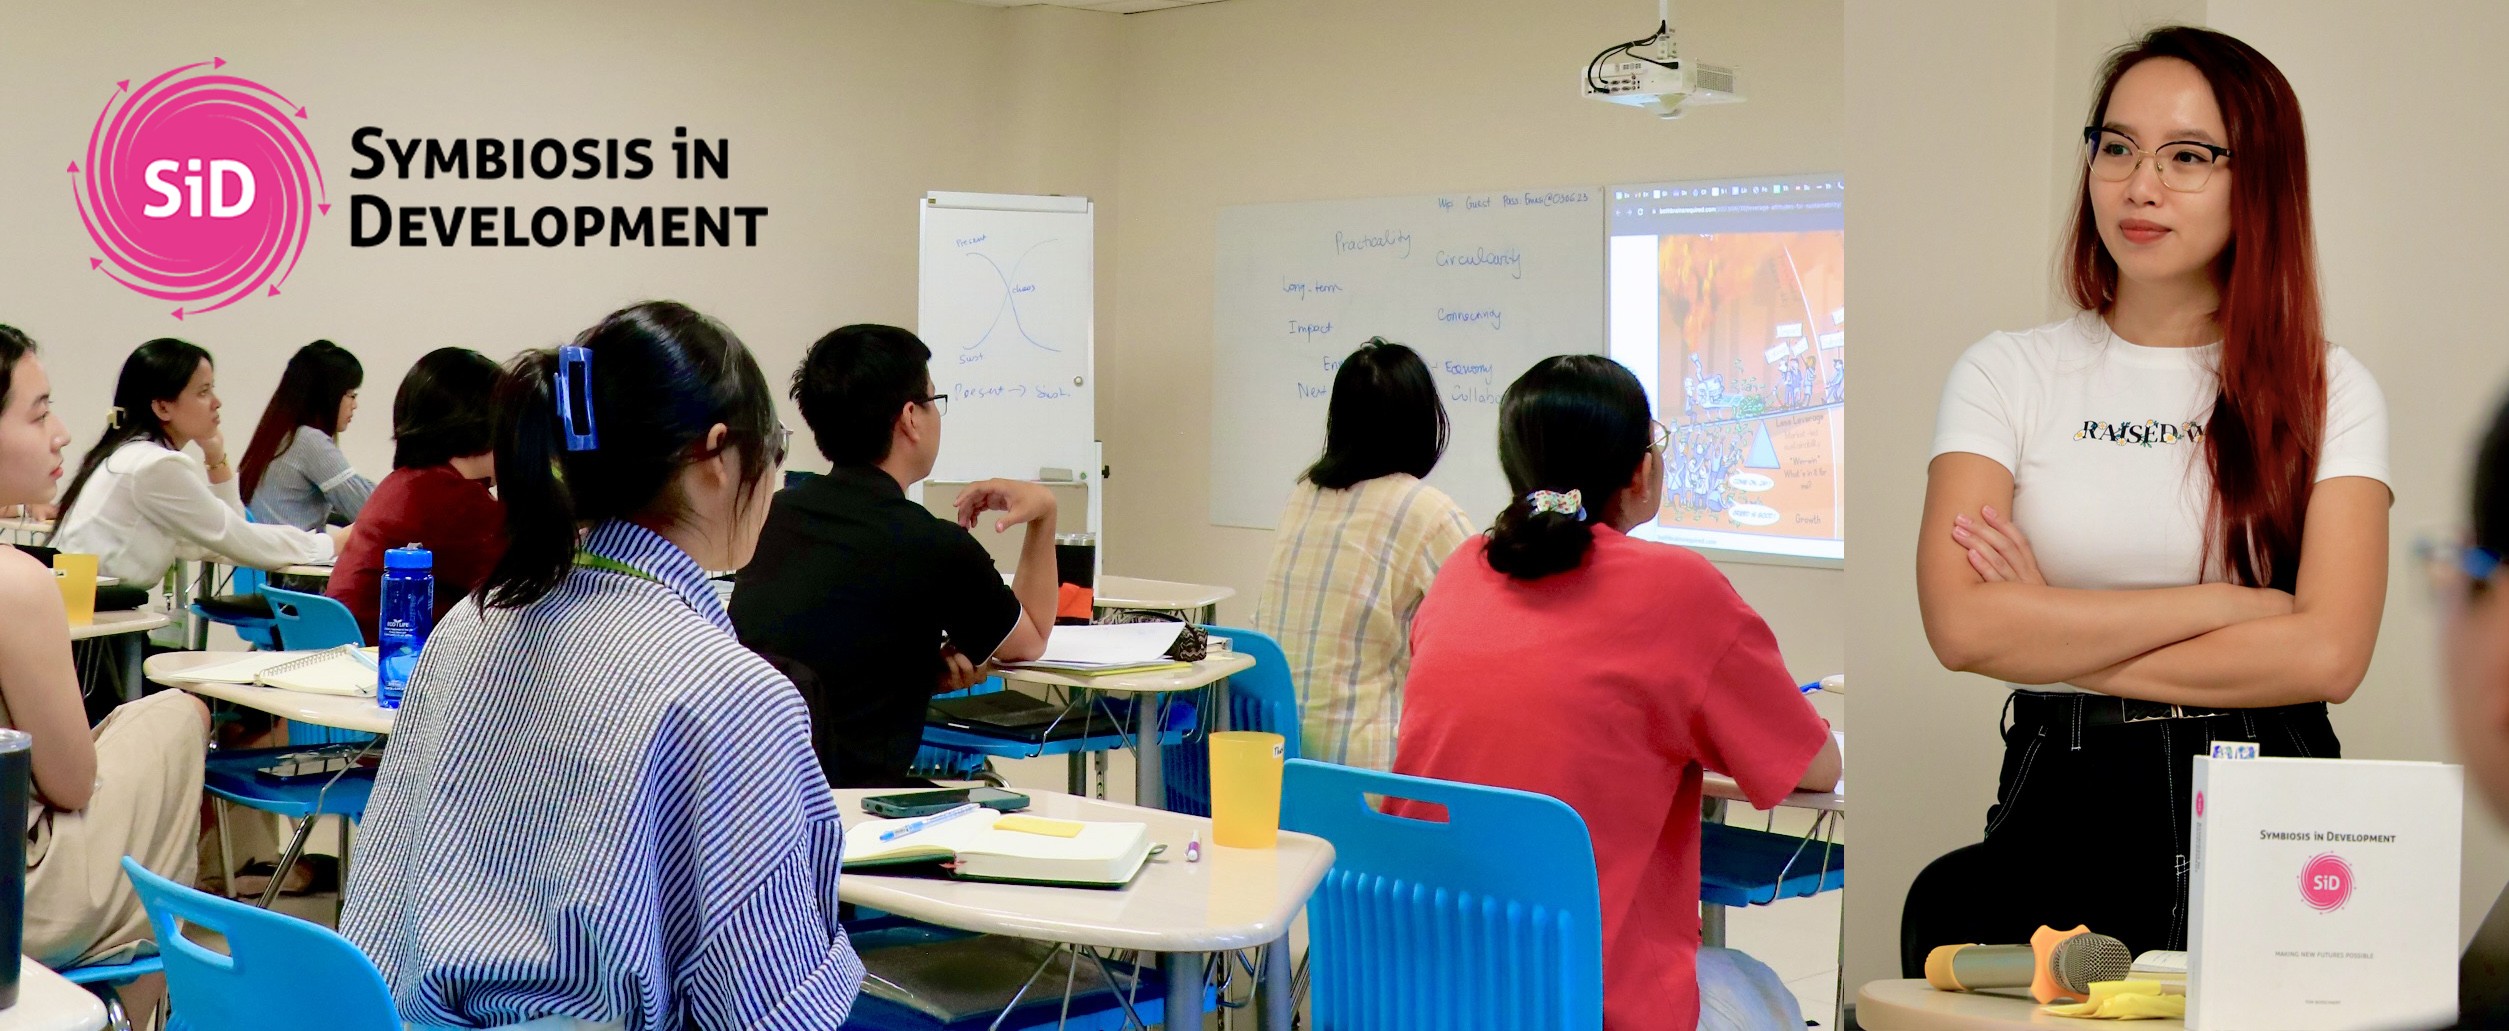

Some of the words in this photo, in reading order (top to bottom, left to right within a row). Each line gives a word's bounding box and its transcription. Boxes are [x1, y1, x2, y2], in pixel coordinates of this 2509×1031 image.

[1335, 230, 1411, 260] Practicality
[1436, 247, 1521, 279] Circularity
[1288, 320, 1333, 343] Impact
[2082, 420, 2178, 444] RAISED
[1795, 513, 1821, 525] Growth
[2312, 874, 2341, 891] SiD
